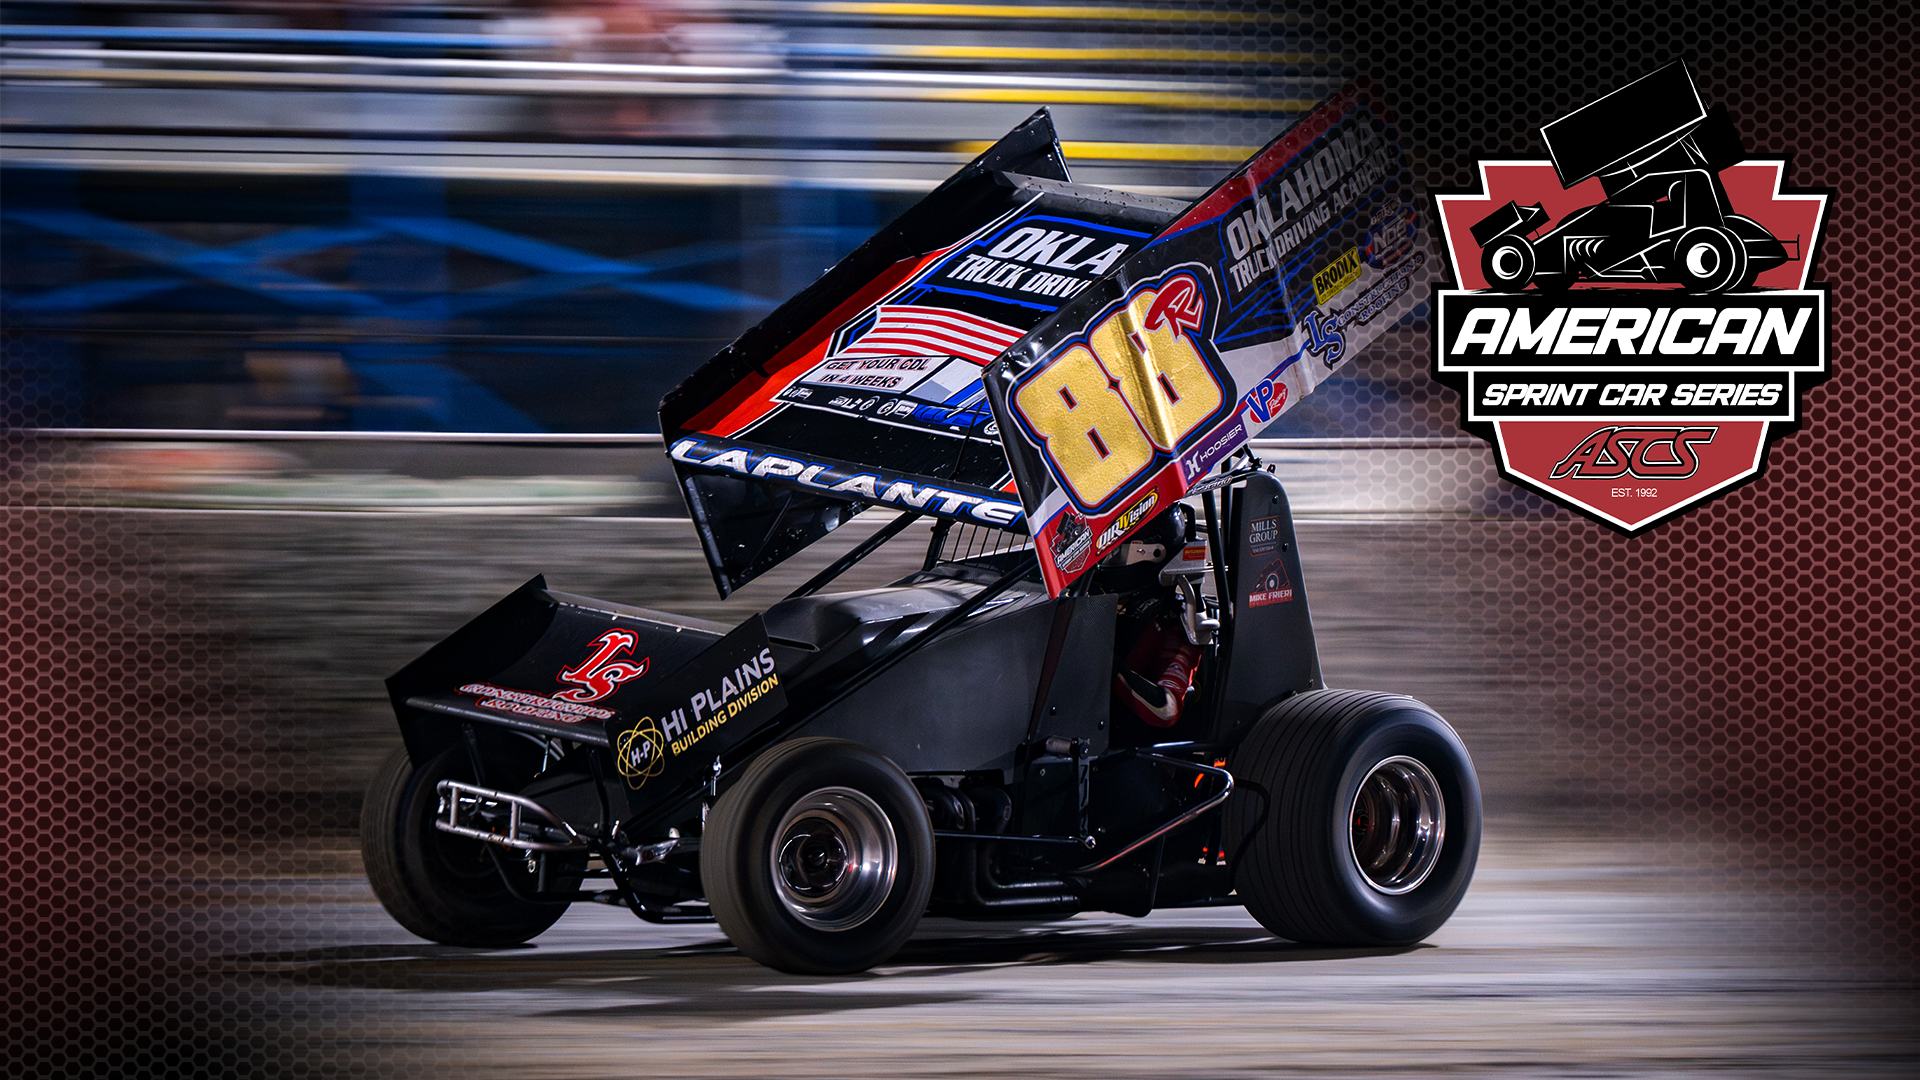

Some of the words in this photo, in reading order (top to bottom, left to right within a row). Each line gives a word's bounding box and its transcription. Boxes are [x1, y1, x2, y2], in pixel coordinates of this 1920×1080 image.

[1227, 116, 1381, 261] OKLAHOMA
[987, 226, 1129, 275] OKLA
[1229, 244, 1277, 293] TRUCK
[1273, 202, 1332, 259] DRIVING
[1373, 208, 1408, 255] NOS
[946, 253, 1032, 289] TRUCK
[1315, 250, 1359, 297] BRODIX
[1337, 257, 1415, 327] CONSTRUCTION
[1360, 278, 1408, 322] ROOFING
[818, 374, 836, 384] IN
[836, 374, 849, 384] 4
[849, 374, 903, 389] WEEKS
[826, 358, 859, 371] GET
[859, 358, 899, 371] YOUR
[899, 357, 930, 371] CDL
[1245, 378, 1275, 423] VP
[1199, 423, 1243, 463] HOOSIER
[670, 439, 1024, 526] LAPLANTE
[1249, 530, 1278, 543] GROUP
[1251, 519, 1277, 533] MILLS
[1249, 592, 1267, 603] MIKE
[660, 707, 688, 742] HI
[690, 647, 775, 722] PLAINS
[671, 710, 727, 756] BUILDING
[727, 673, 779, 718] DIVISION
